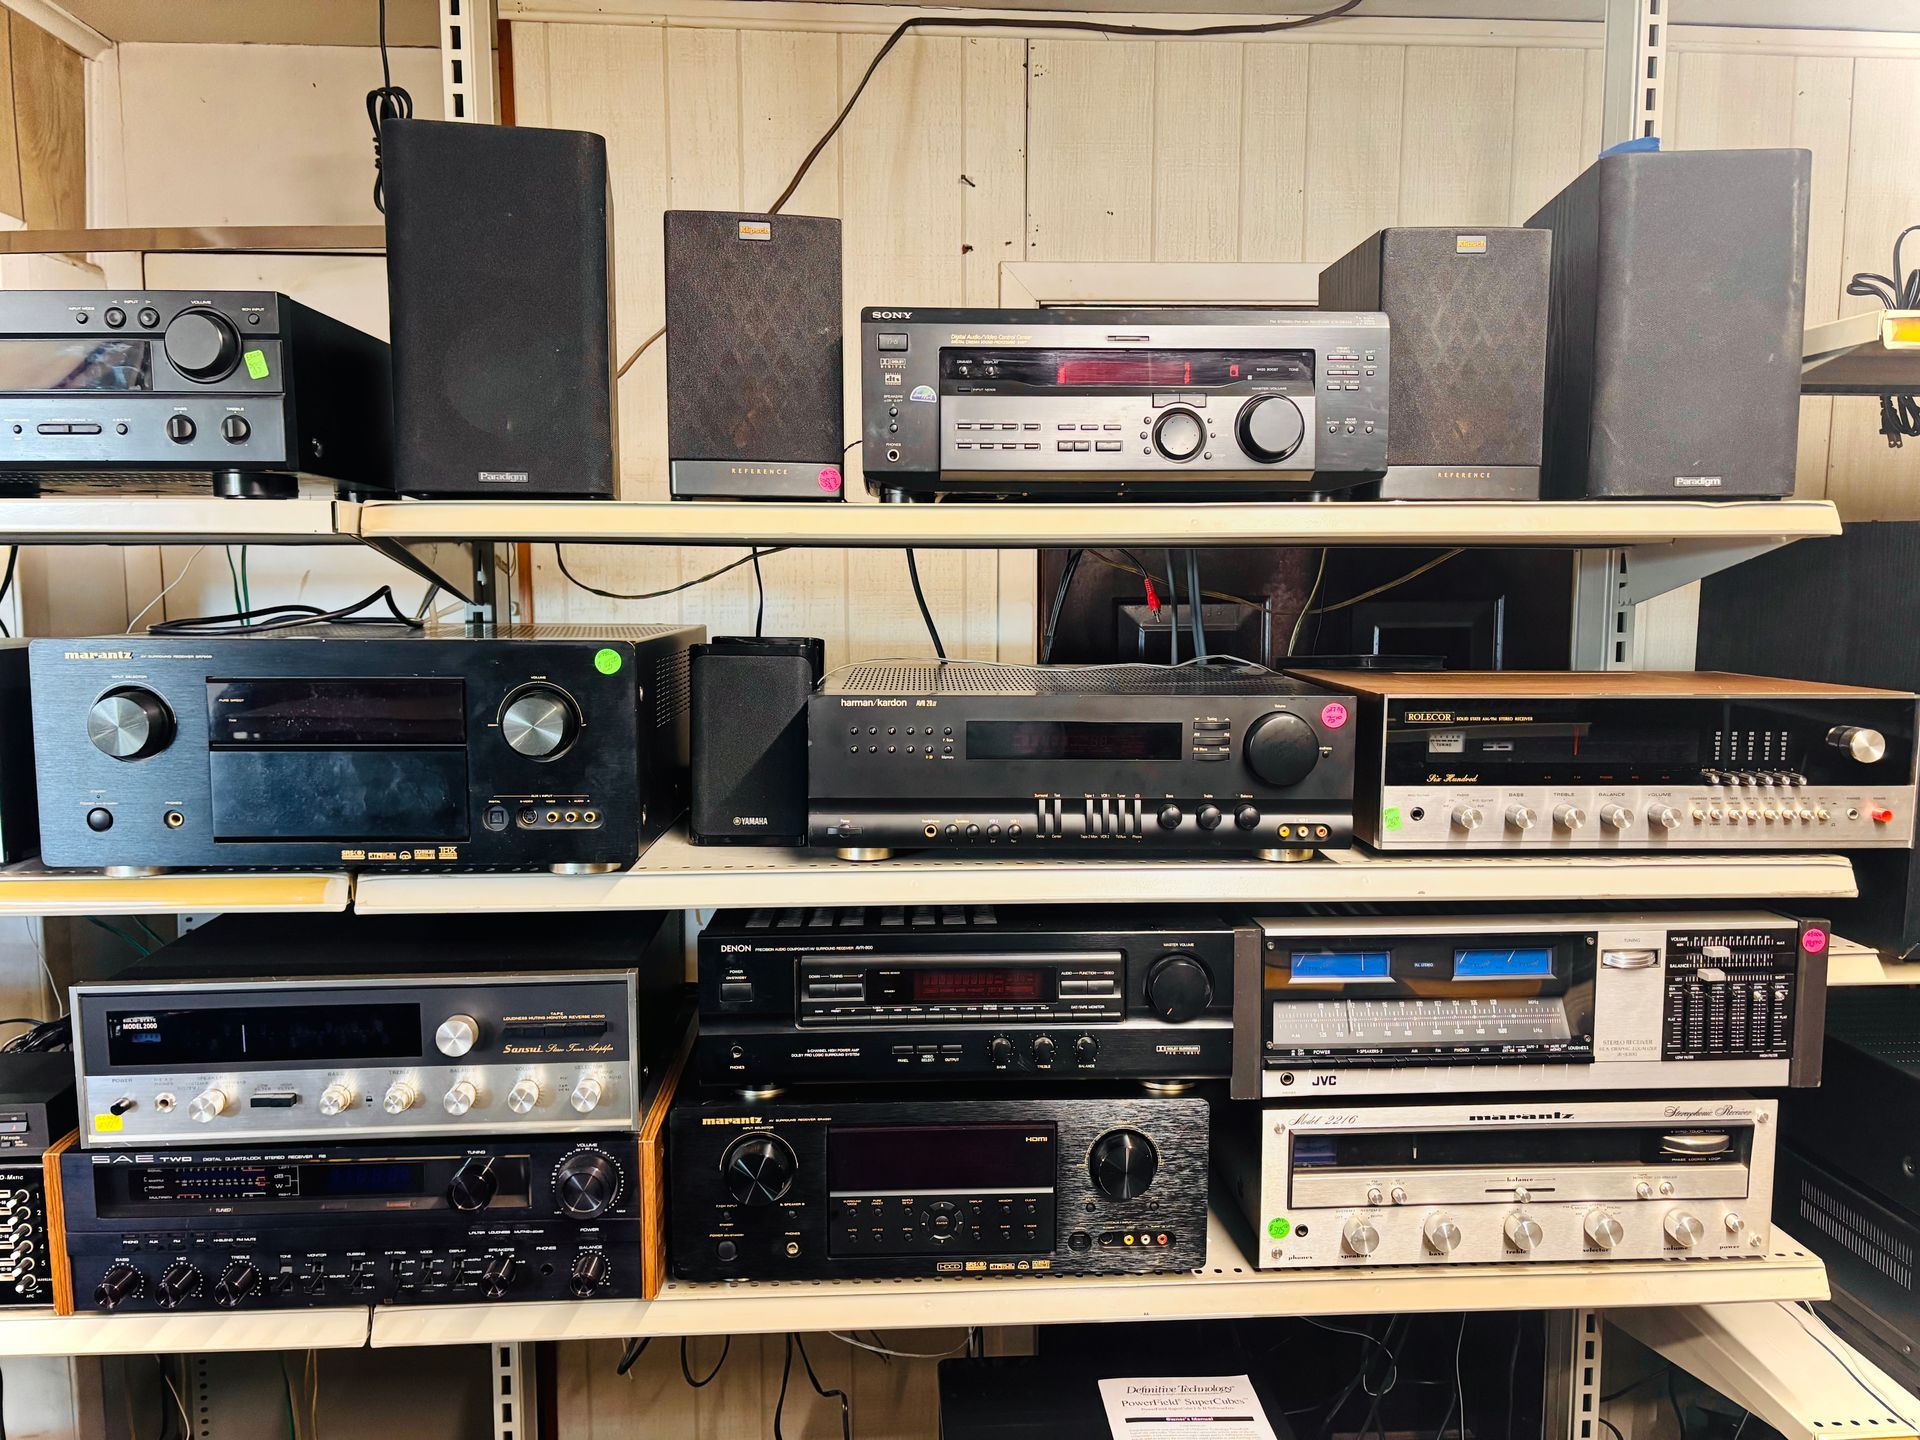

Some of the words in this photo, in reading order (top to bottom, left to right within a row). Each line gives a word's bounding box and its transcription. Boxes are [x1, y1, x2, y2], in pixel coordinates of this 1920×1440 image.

[872, 312, 912, 320] SONY
[731, 468, 788, 476] REFERENCE
[480, 472, 528, 482] Paradigm
[1676, 477, 1721, 488] Paradigm
[64, 651, 134, 660] marantz
[840, 698, 907, 707] harman/kardon
[1408, 713, 1452, 721] ROLECOR
[1426, 774, 1442, 783] Six
[1443, 774, 1480, 783] Hundred
[742, 817, 768, 826] YAMAHA
[721, 945, 752, 953] DENON
[503, 1044, 542, 1054] Sansui
[1312, 1075, 1337, 1086] JVC
[1469, 1112, 1574, 1120] marantz
[1664, 1106, 1713, 1120] Stereophonic
[1715, 1105, 1753, 1116] Receiver
[702, 1117, 763, 1126] marantz
[1288, 1113, 1319, 1126] Model
[1324, 1115, 1358, 1125] 2216
[92, 1155, 154, 1164] SAE
[1126, 1385, 1177, 1394] Definitive
